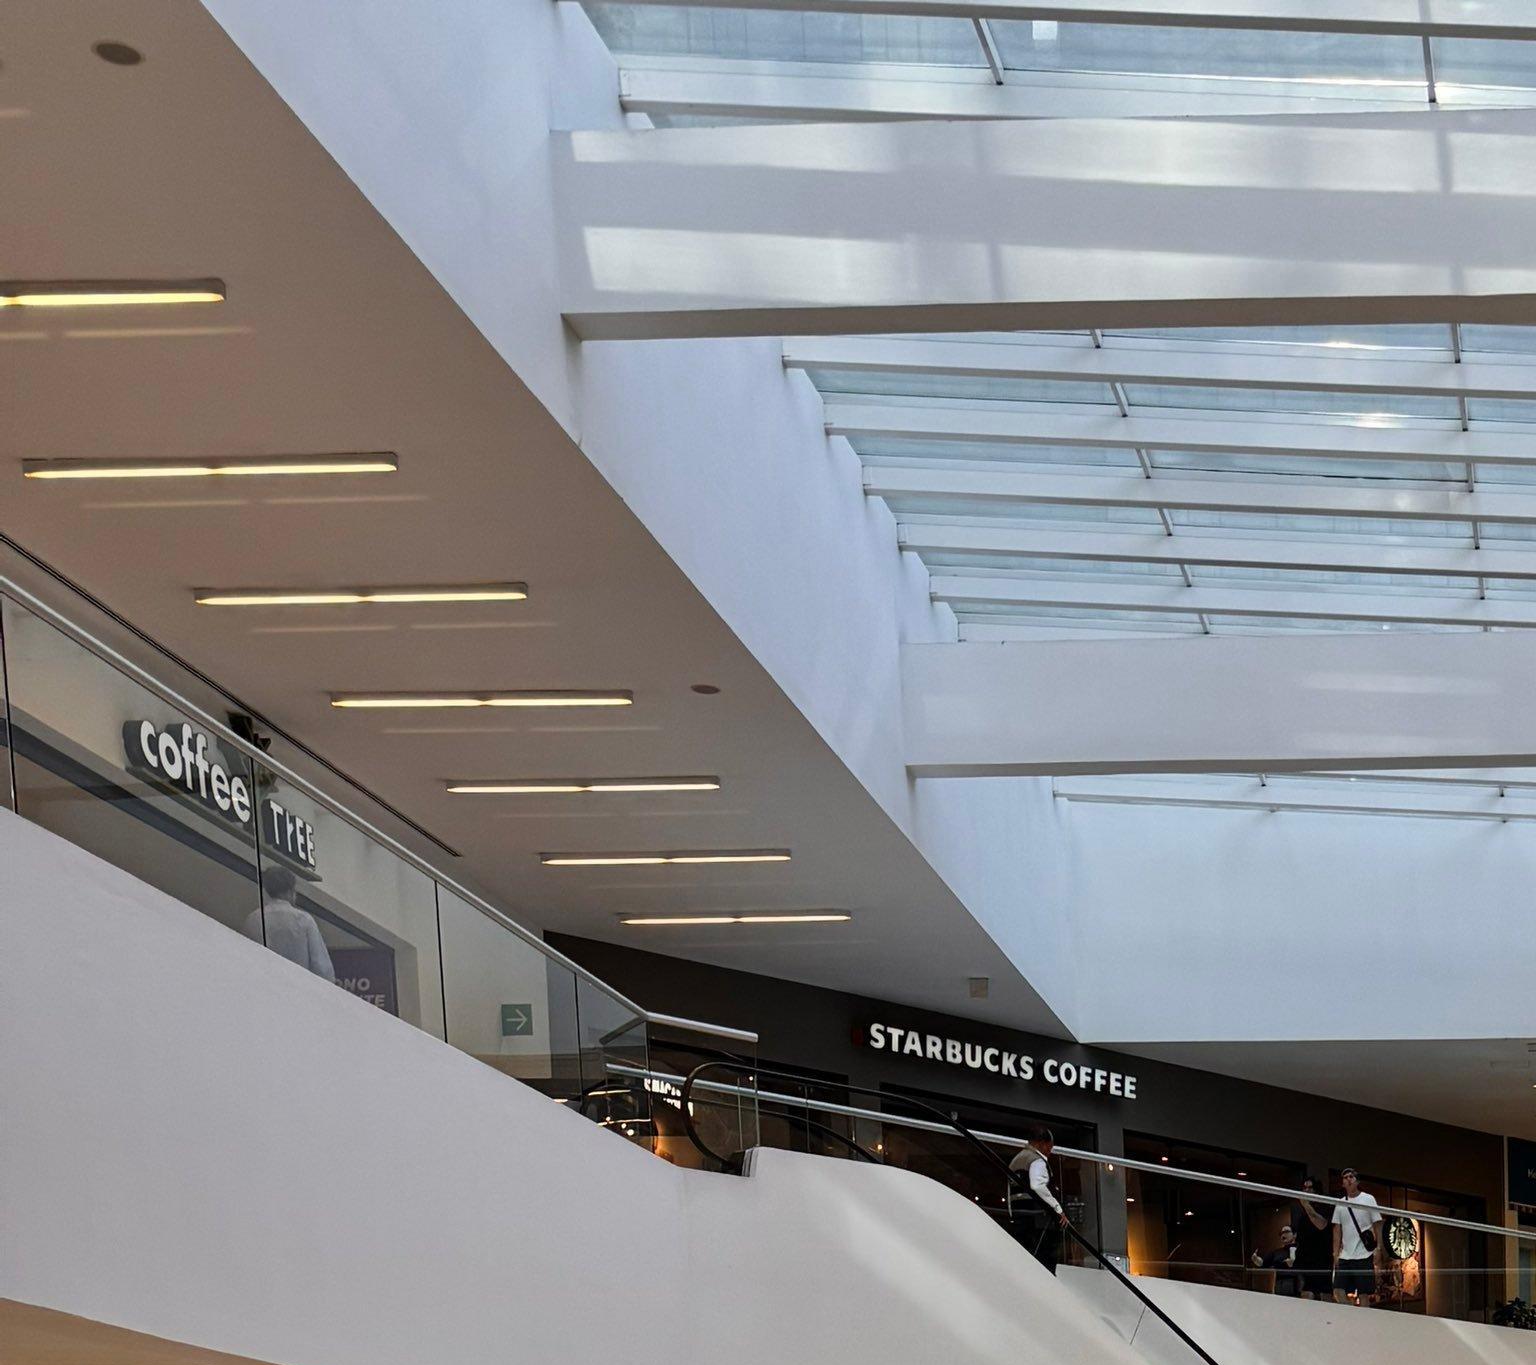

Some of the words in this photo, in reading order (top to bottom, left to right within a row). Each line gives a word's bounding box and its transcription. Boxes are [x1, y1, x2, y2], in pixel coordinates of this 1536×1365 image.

[140, 720, 250, 823] coffee
[869, 1022, 1034, 1081] STARBUCKS
[1043, 1058, 1138, 1100] COFFEE
